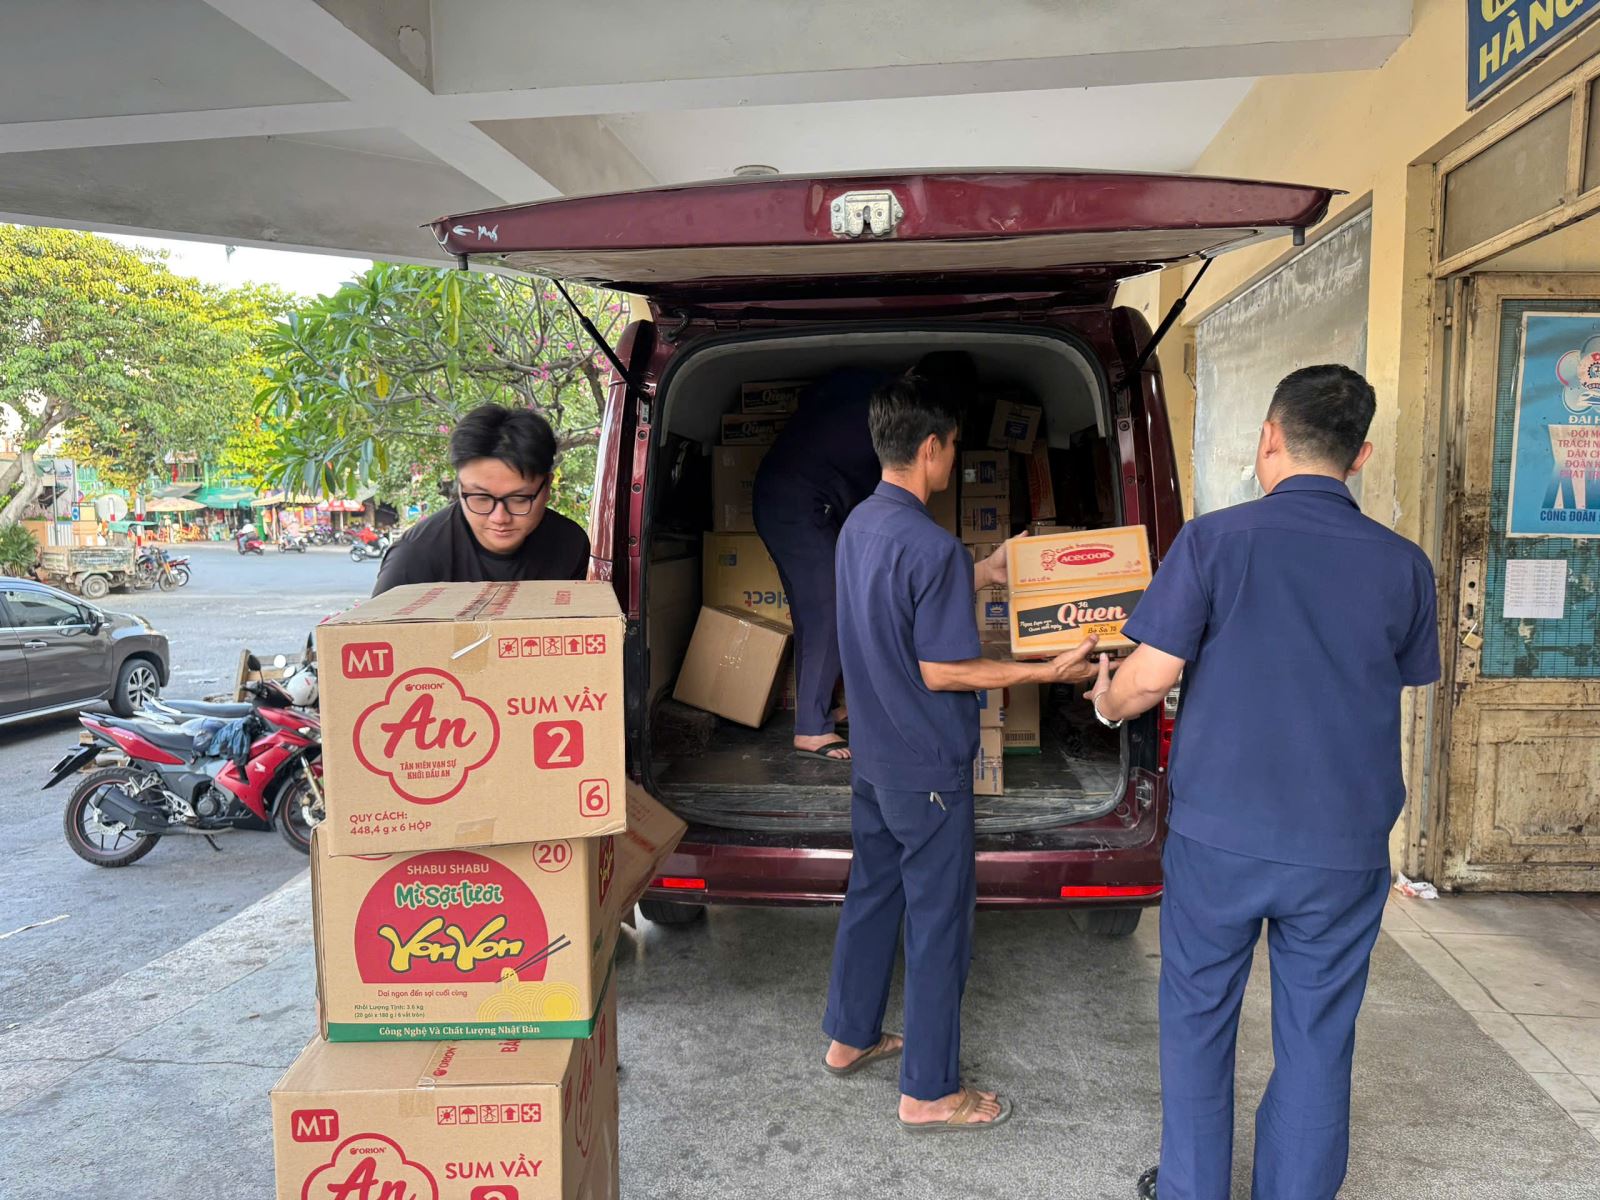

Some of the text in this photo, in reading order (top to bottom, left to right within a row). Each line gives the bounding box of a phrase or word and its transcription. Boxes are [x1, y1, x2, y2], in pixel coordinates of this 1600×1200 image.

[1591, 429, 1600, 438] M
[743, 591, 789, 608] elect
[1057, 603, 1127, 627] Quen
[347, 650, 388, 672] MT
[414, 683, 443, 691] ORION
[506, 696, 558, 716] SUM
[380, 693, 477, 759] An
[546, 726, 572, 764] 2
[585, 785, 604, 811] 6
[349, 811, 408, 825] QUY CÁCH:
[350, 825, 380, 835] 448,4
[400, 823, 406, 832] 6
[409, 820, 432, 832] HỘP
[538, 844, 567, 864] 20
[407, 863, 490, 875] SHABU SHABU
[379, 1024, 540, 1037] Công Nghệ Và Chất Lượng Nhật Bản
[296, 1115, 335, 1137] MT
[445, 1162, 495, 1179] SUM
